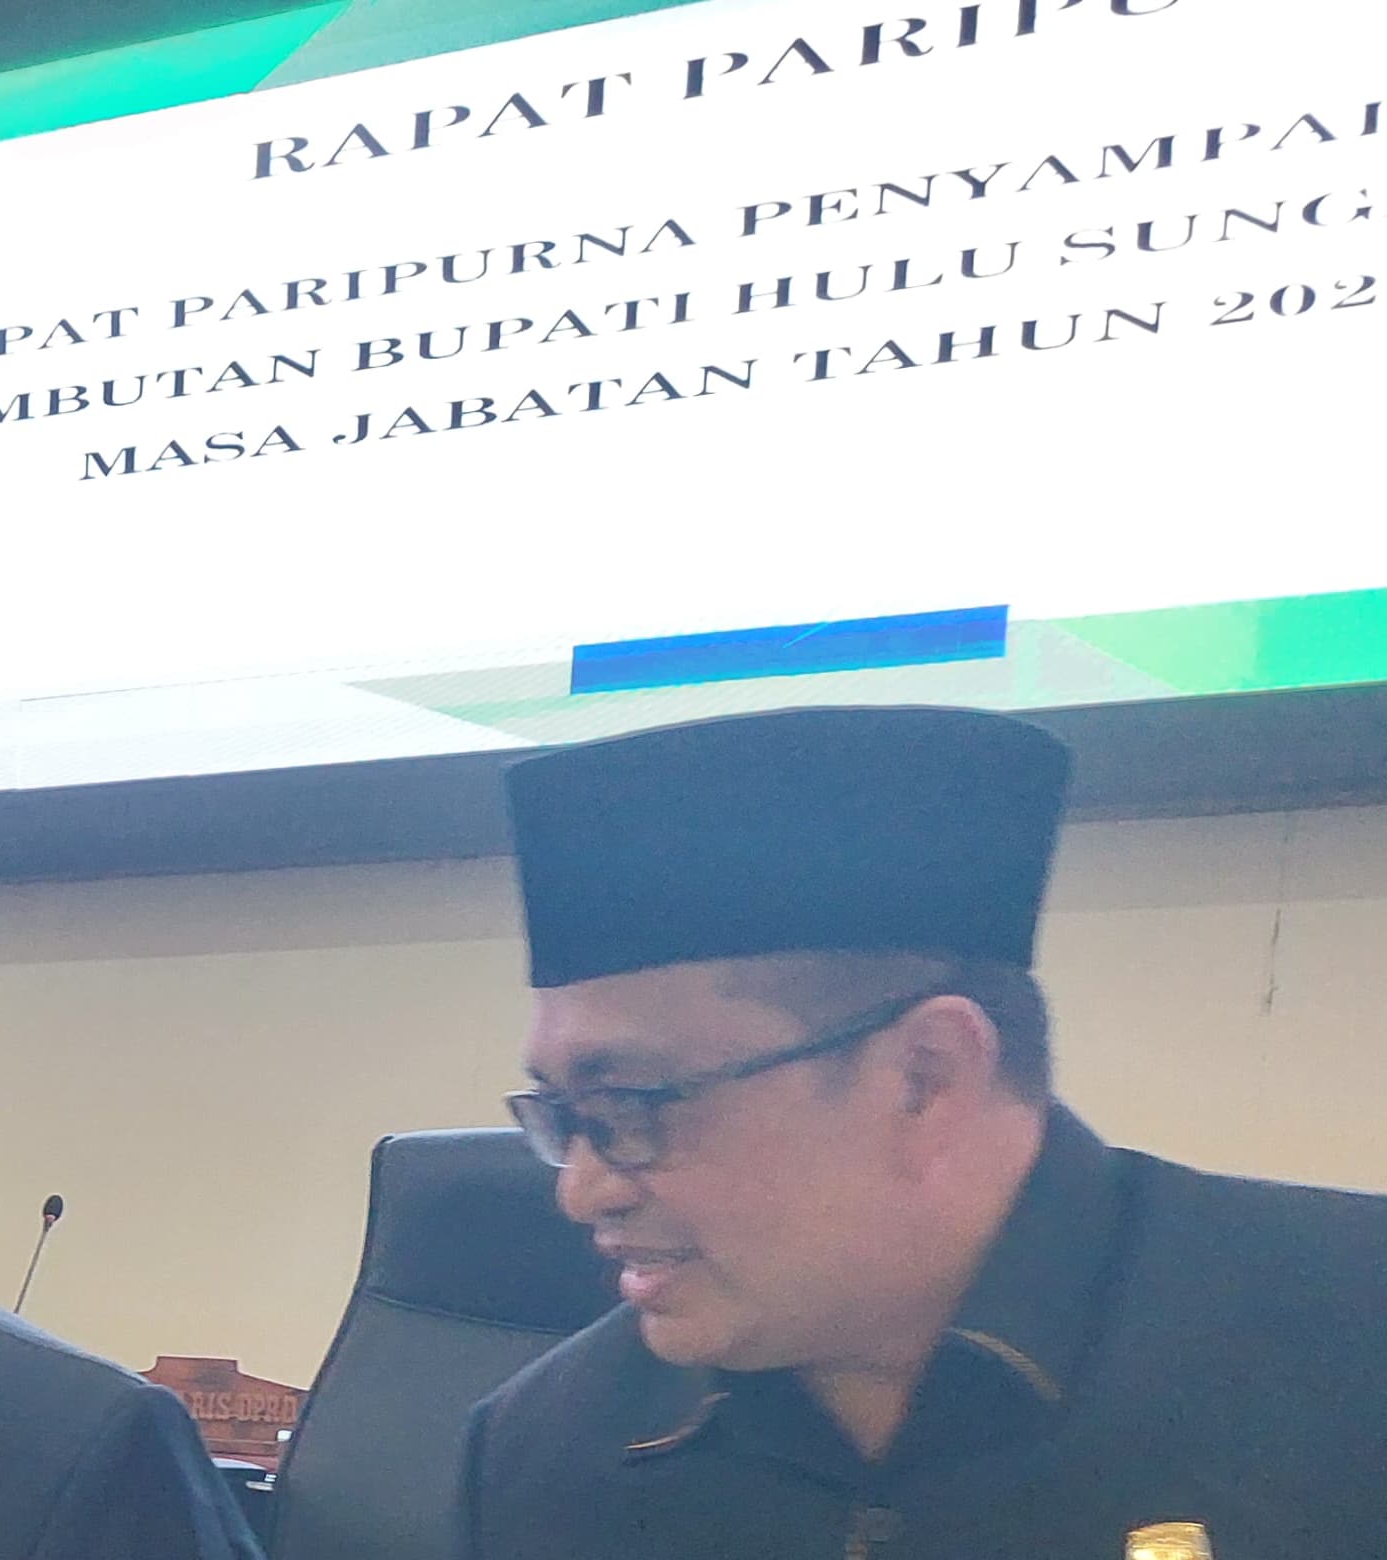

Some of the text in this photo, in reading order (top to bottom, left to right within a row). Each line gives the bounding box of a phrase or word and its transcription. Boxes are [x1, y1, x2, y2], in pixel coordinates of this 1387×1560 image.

[251, 71, 633, 181] RAPAT
[170, 217, 697, 329] PARIPURNA
[352, 291, 693, 372] BUPATI
[731, 241, 1022, 316] HULU
[78, 274, 1377, 481] MASA JABATAN TAHUN 202
